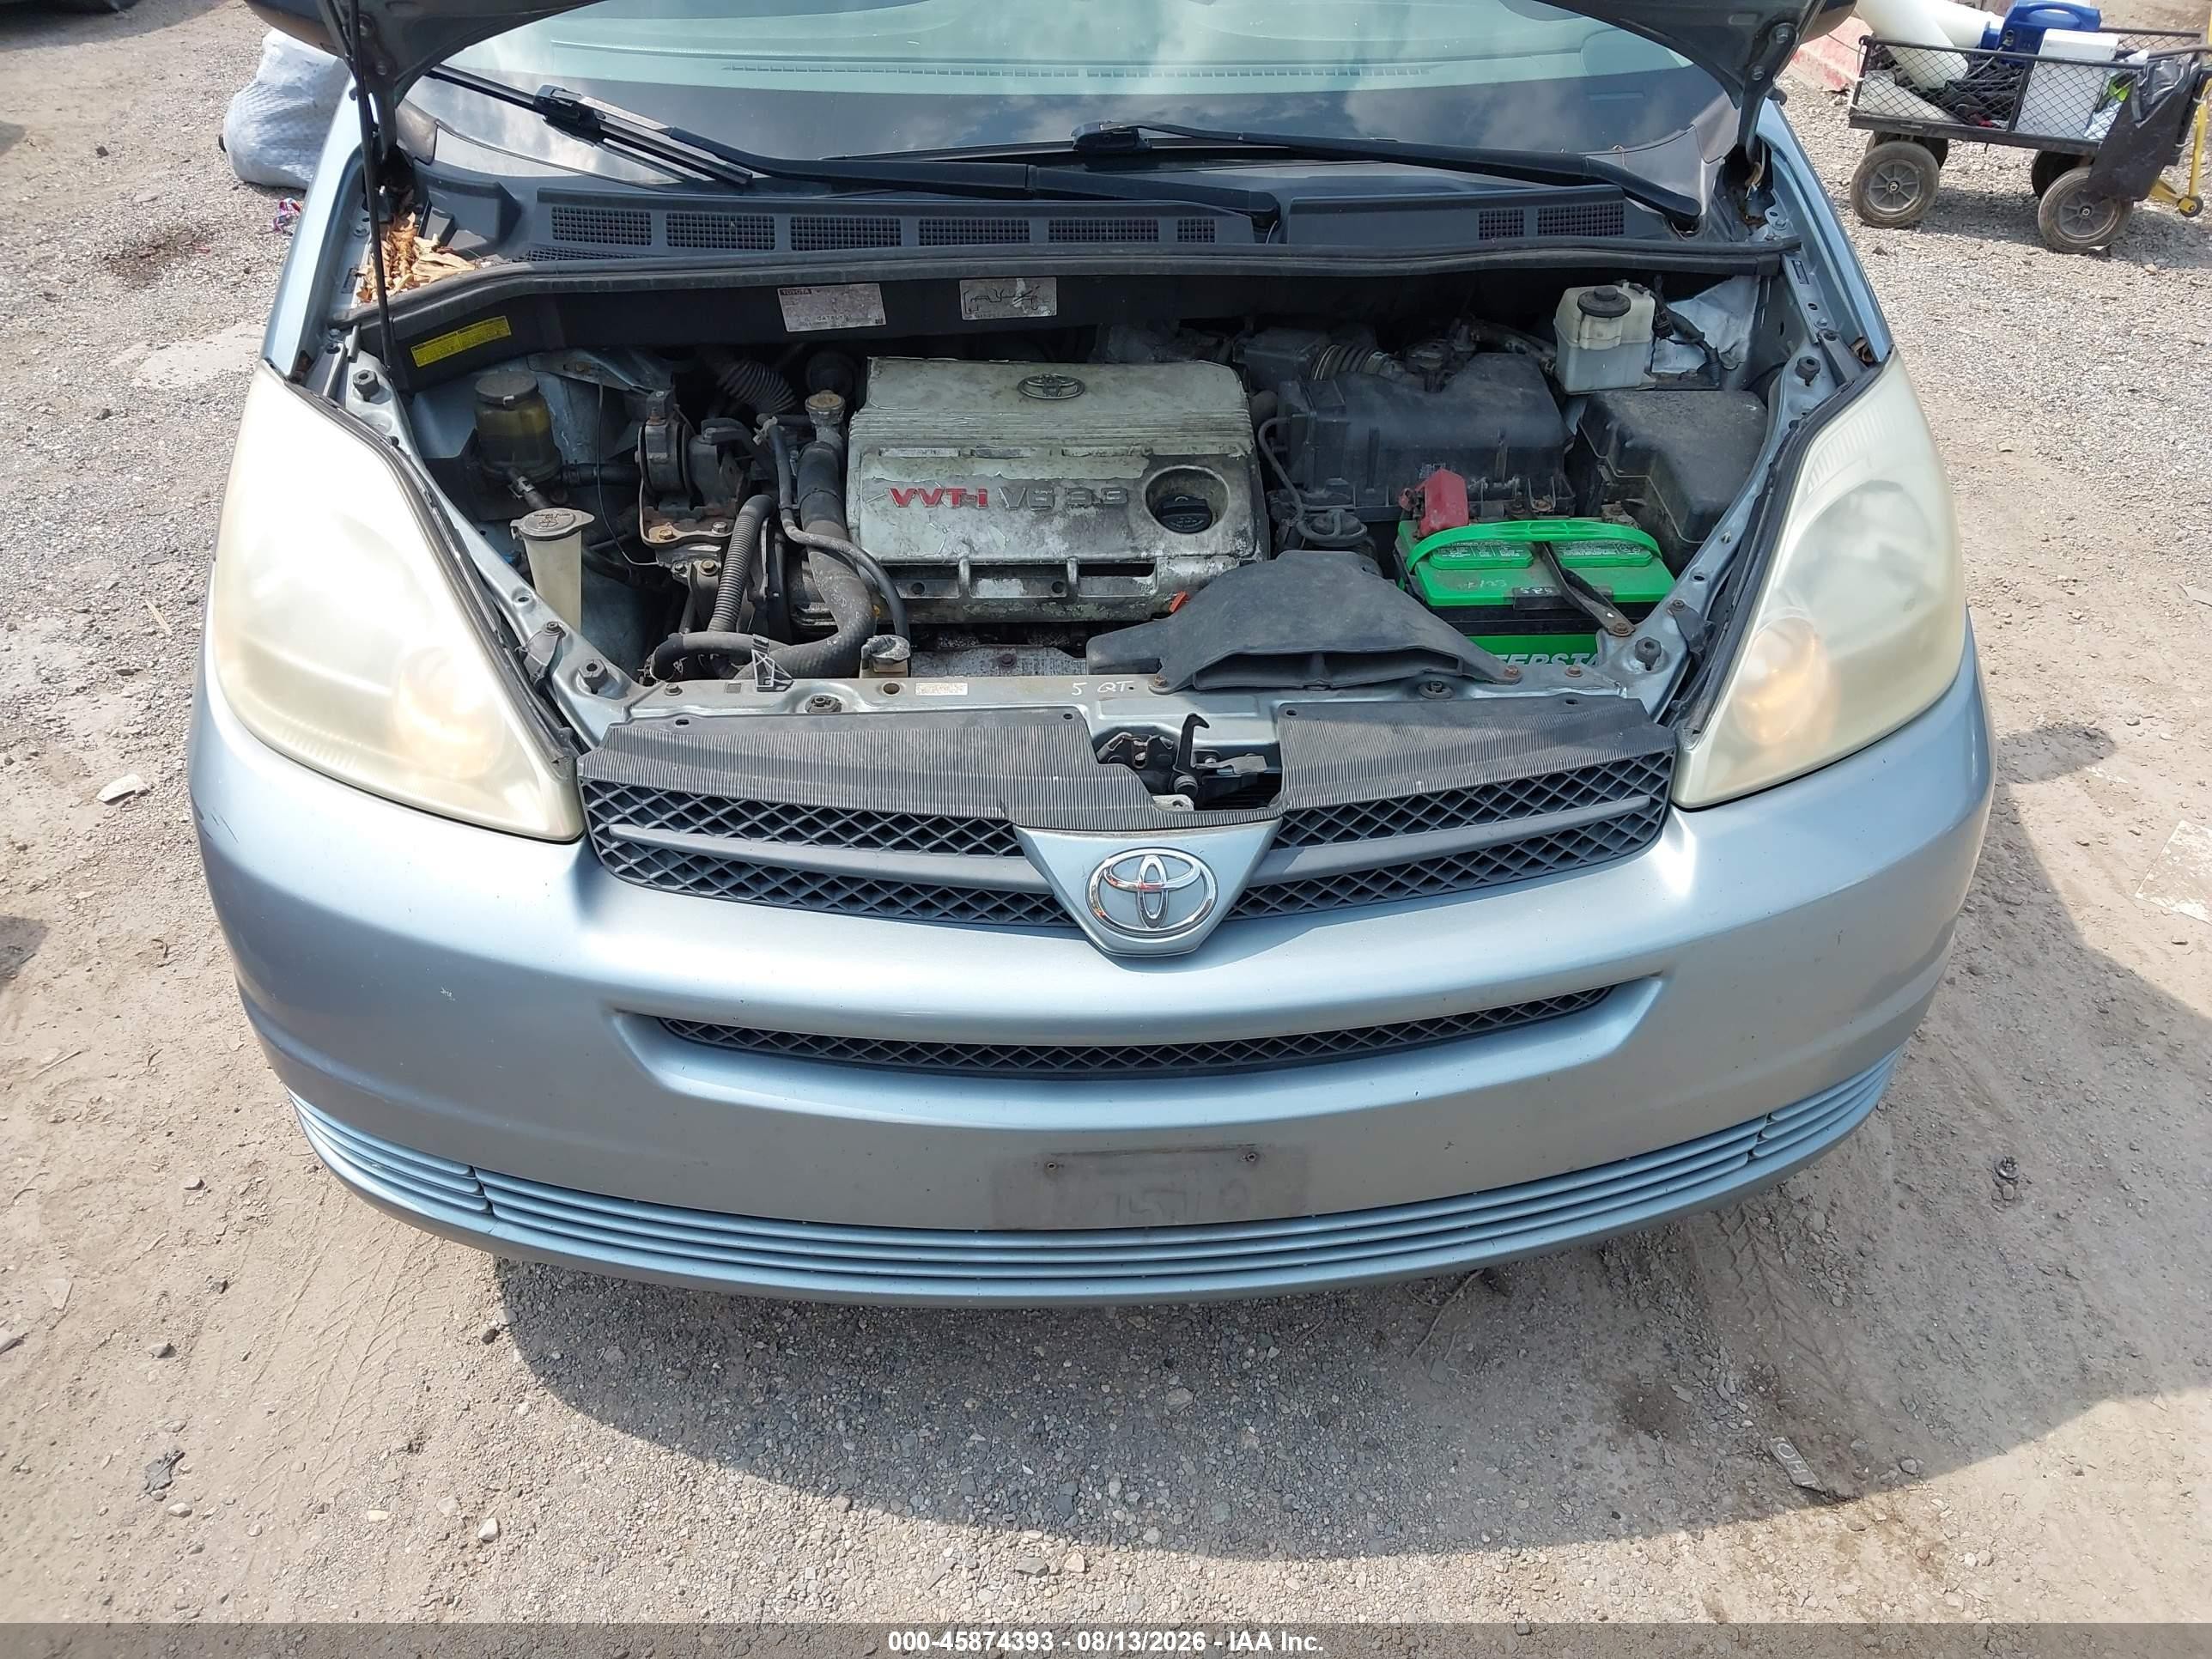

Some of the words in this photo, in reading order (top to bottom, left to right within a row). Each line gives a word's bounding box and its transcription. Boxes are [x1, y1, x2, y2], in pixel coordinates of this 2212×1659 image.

[889, 487, 988, 508] VVT-i
[999, 487, 1055, 511] V6
[1065, 487, 1128, 507] 3.3
[1493, 653, 1599, 666] ERST
[1071, 681, 1088, 696] 5
